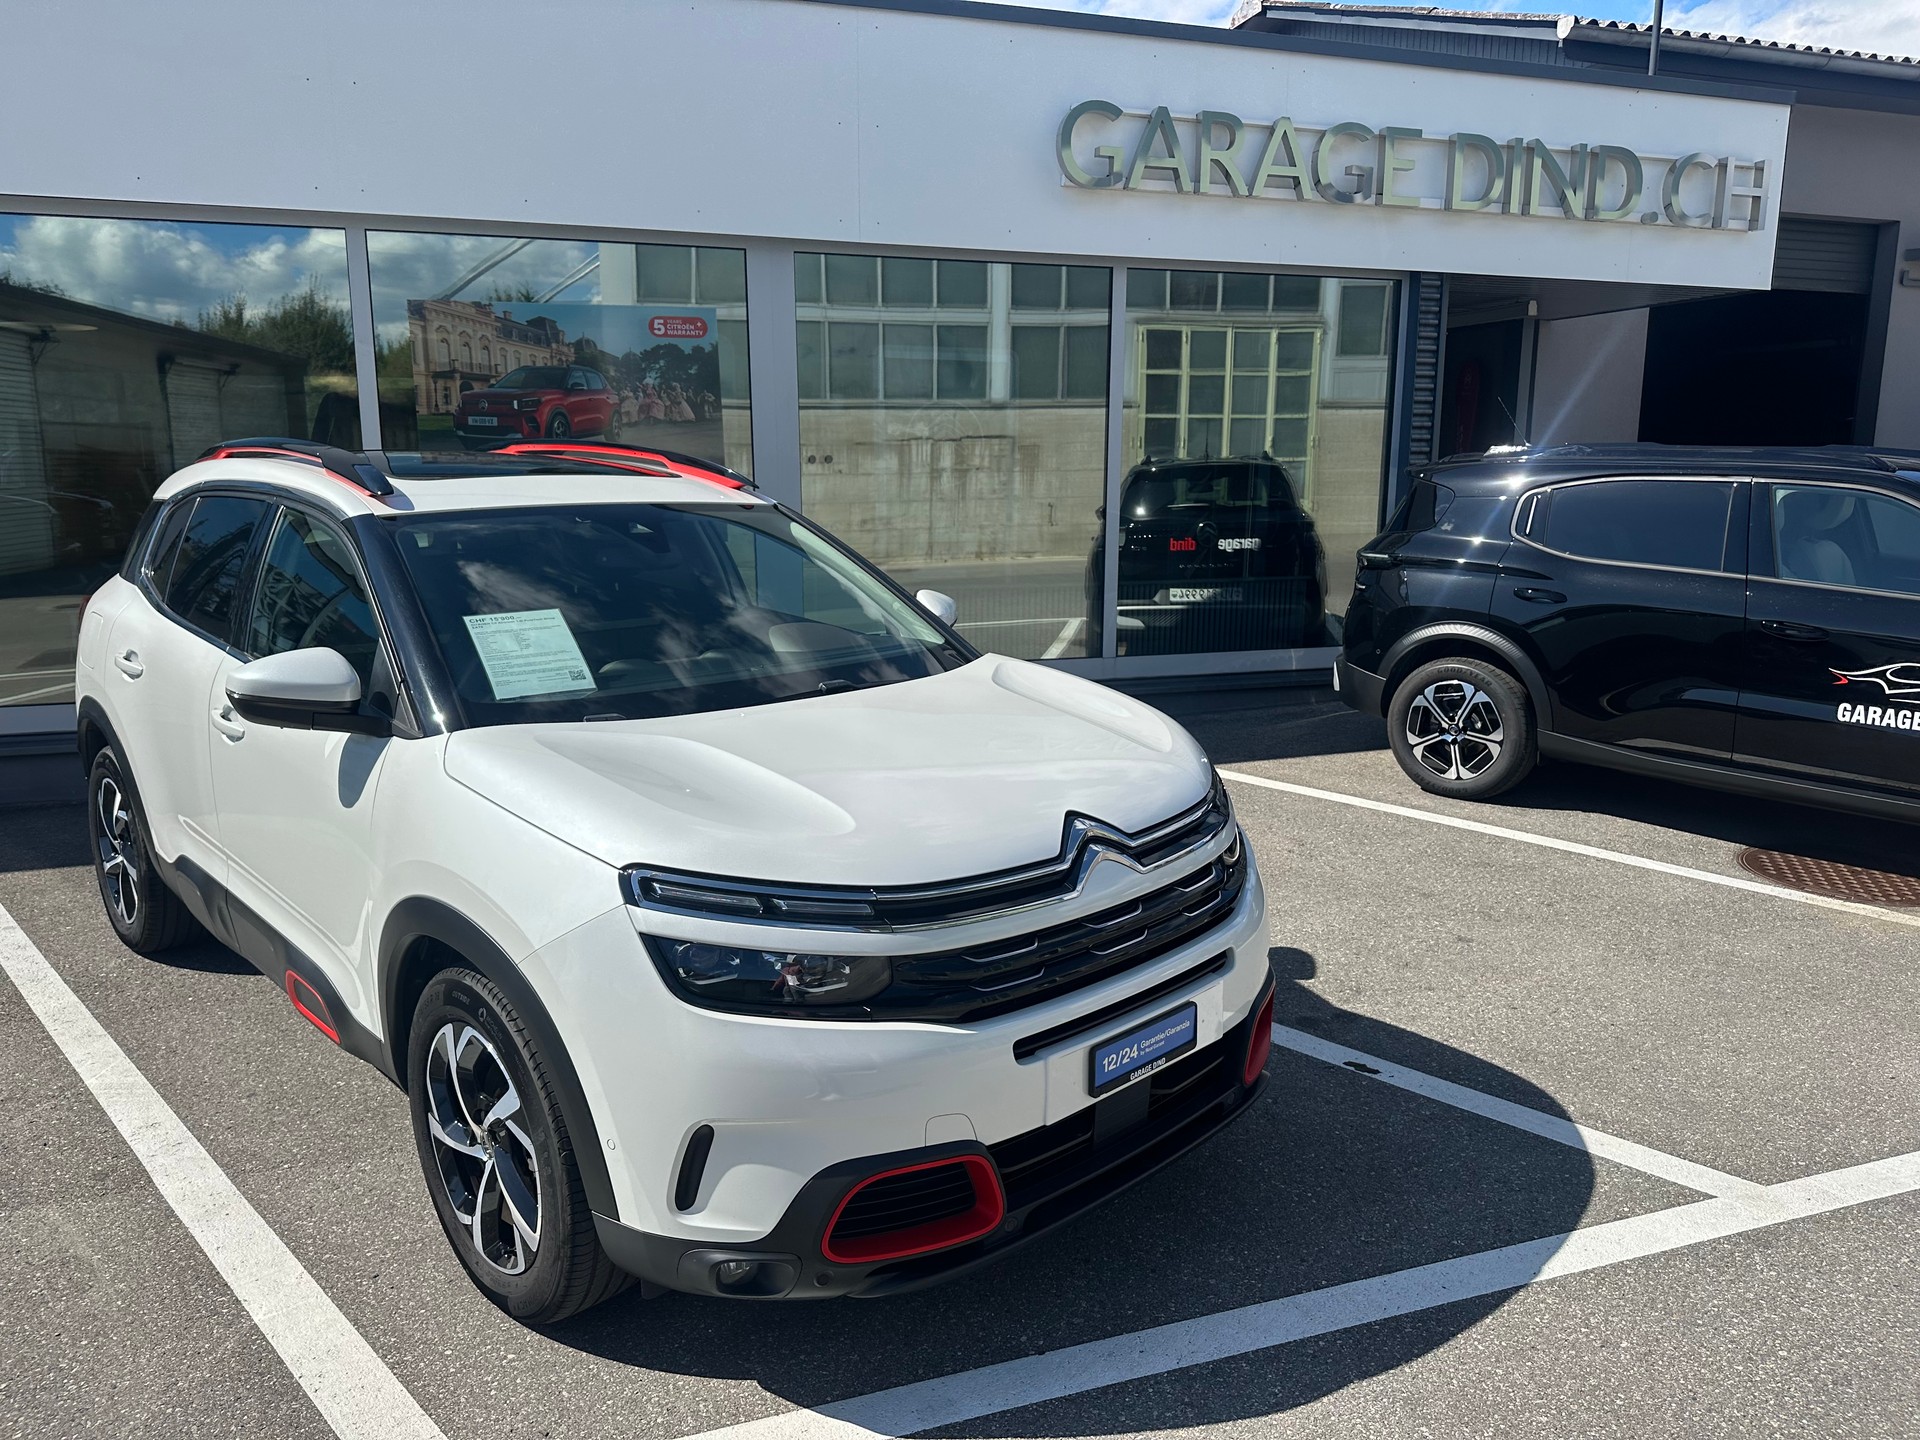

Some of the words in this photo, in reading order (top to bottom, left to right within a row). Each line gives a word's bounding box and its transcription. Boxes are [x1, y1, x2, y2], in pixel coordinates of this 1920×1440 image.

[1056, 100, 1423, 207] GARAGE
[1444, 132, 1769, 232] DIND.CH
[653, 319, 665, 335] 5
[1837, 702, 1920, 731] GARAGE
[1140, 1020, 1190, 1048] Garantie/Garanzia
[1103, 1043, 1138, 1072] 12/24
[1130, 1064, 1152, 1080] GARAGE
[1153, 1057, 1166, 1069] DIND
